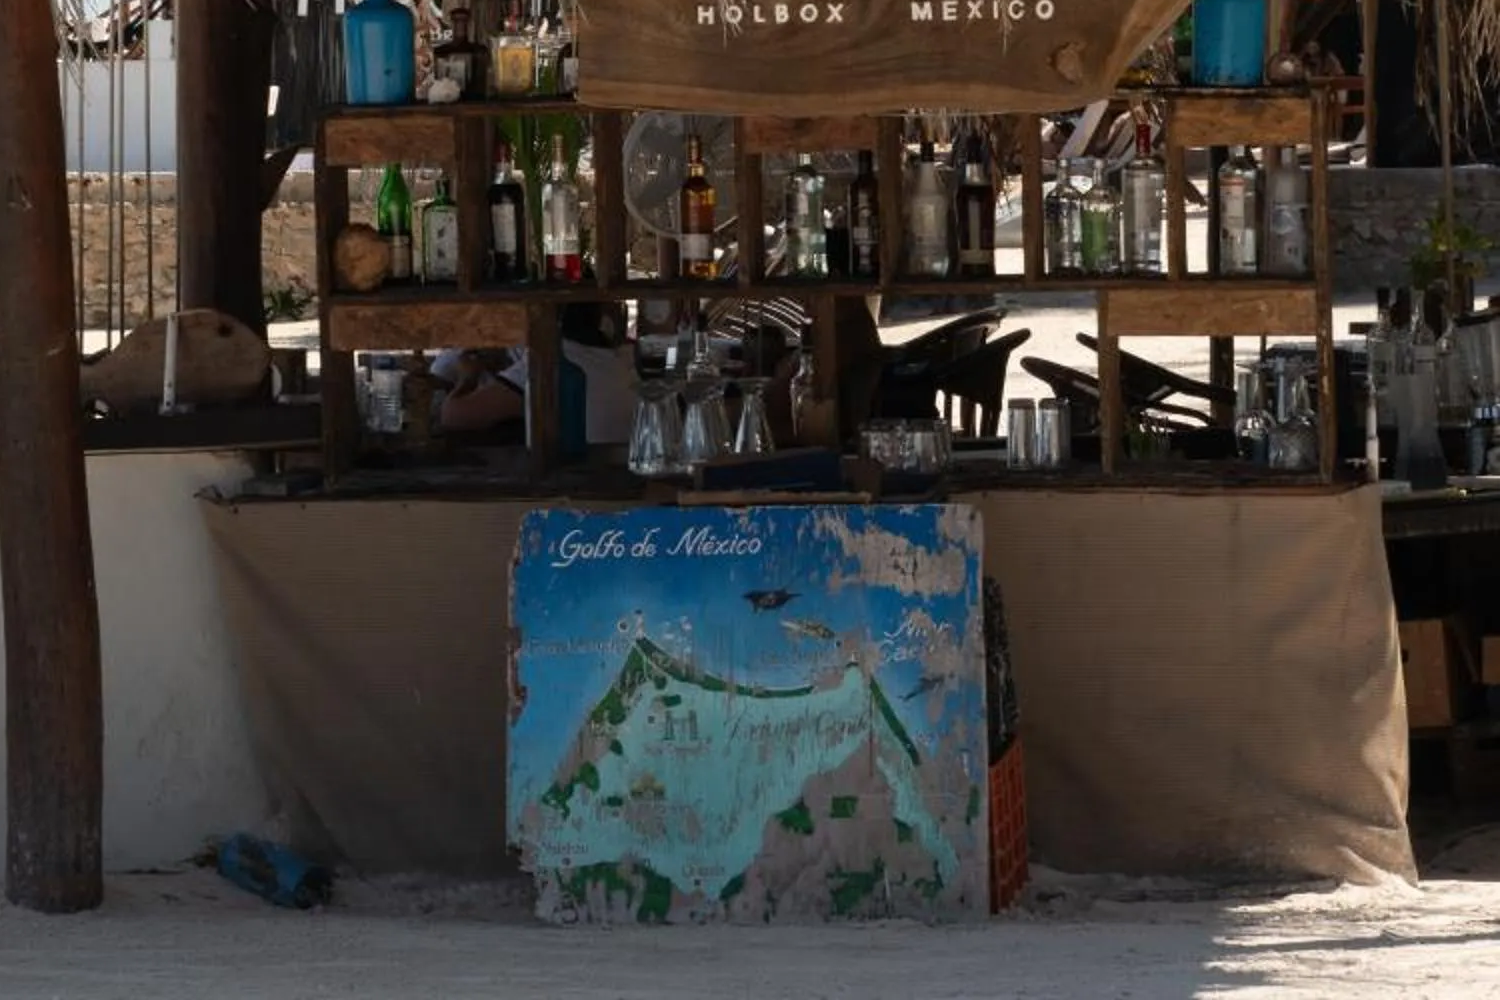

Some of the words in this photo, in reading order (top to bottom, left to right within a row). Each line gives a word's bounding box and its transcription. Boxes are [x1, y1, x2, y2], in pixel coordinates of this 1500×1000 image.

[697, 3, 844, 25] HOLBOX
[911, 0, 1055, 21] MEXICO
[551, 529, 625, 567] Golfo
[631, 526, 661, 557] de
